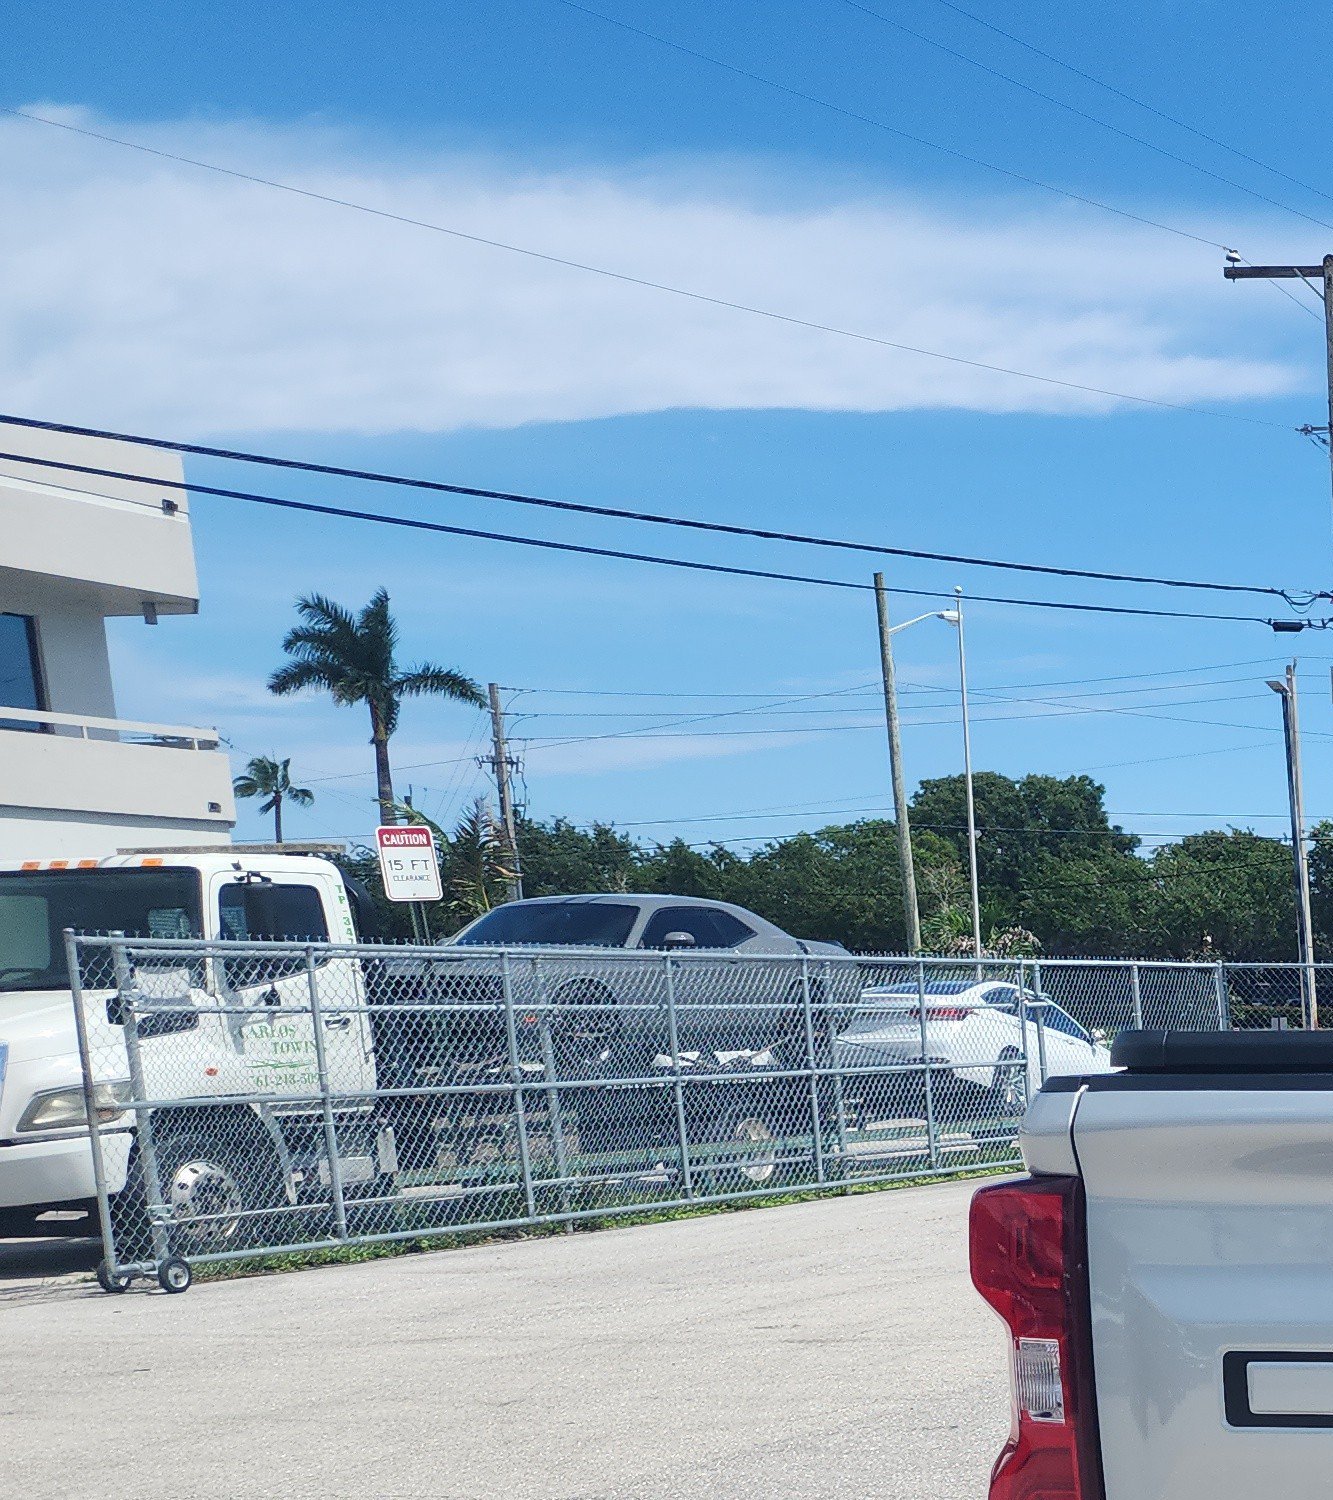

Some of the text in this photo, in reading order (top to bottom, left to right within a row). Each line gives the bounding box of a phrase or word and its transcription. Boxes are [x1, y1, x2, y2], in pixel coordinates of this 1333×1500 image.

[382, 834, 428, 845] CAUTION
[388, 860, 430, 871] 15 FT
